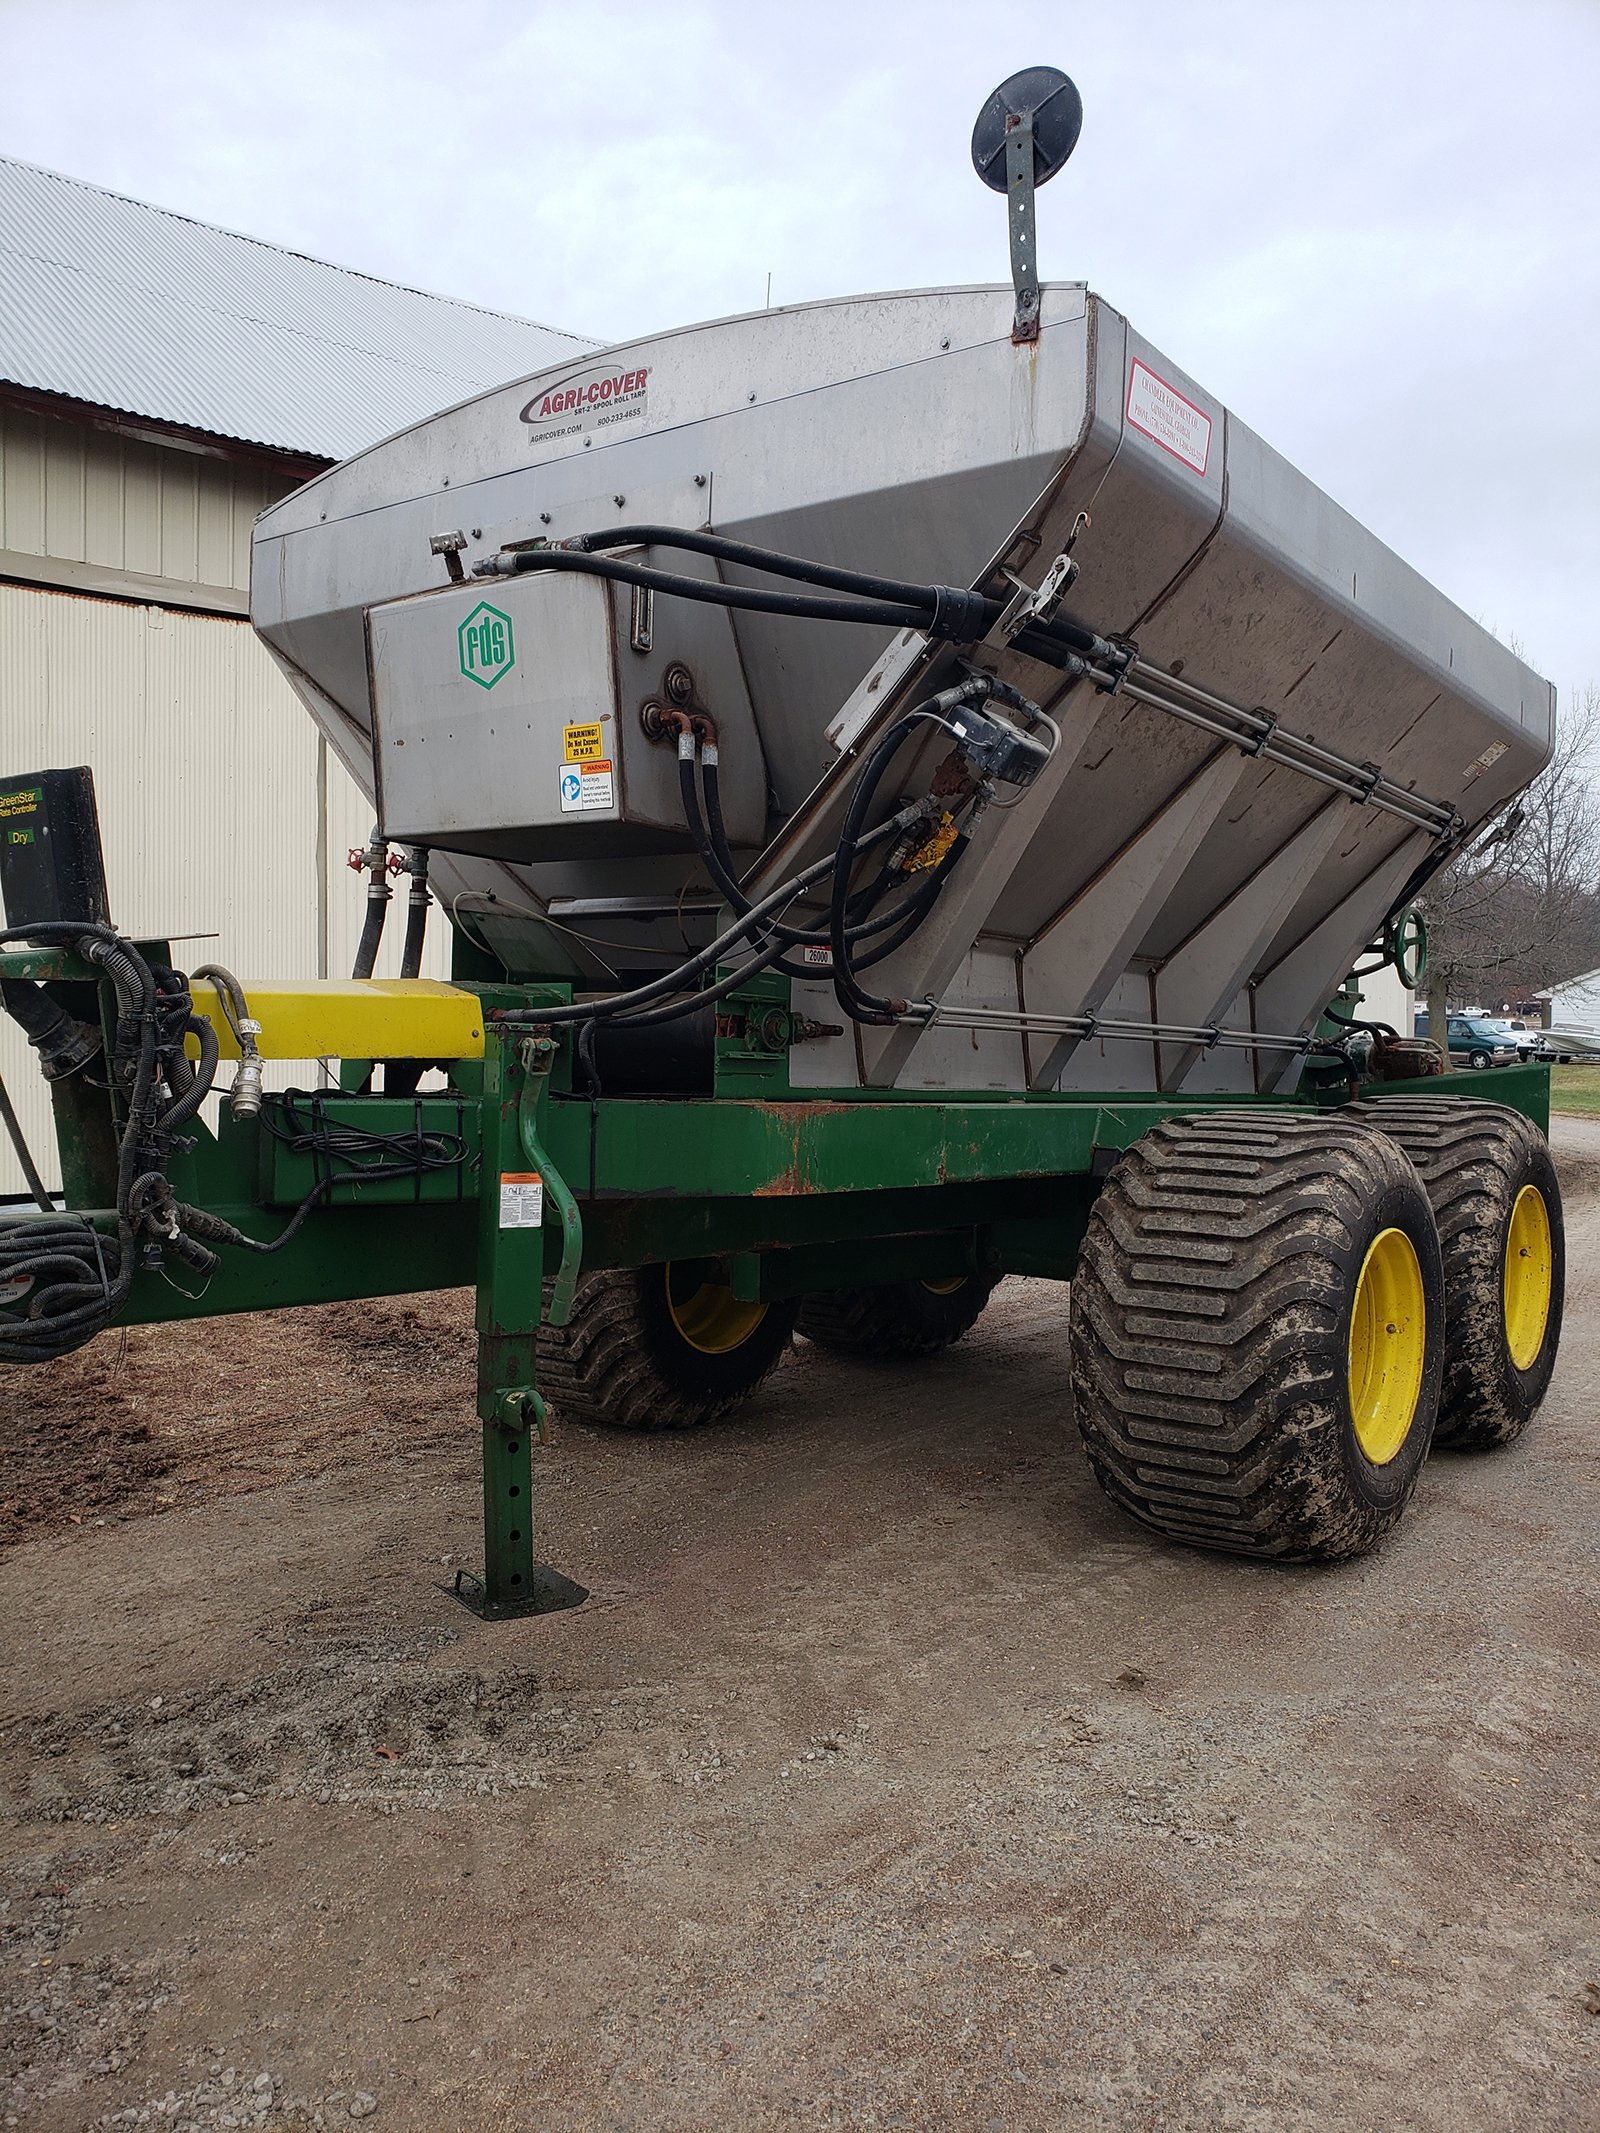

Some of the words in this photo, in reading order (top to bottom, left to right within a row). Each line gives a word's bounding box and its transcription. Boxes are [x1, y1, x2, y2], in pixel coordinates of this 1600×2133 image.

[539, 369, 648, 417] AGRI-COVER
[593, 400, 613, 411] SPOOL
[614, 395, 629, 404] ROLL
[630, 390, 646, 400] TARP
[597, 407, 641, 426] 800-233-4655
[530, 424, 582, 444] AGRICOVER.COM
[568, 728, 598, 739] WARNING!
[574, 739, 582, 747] Not
[587, 764, 609, 772] WARNING
[12, 804, 37, 815] Controller
[13, 832, 28, 845] Dry
